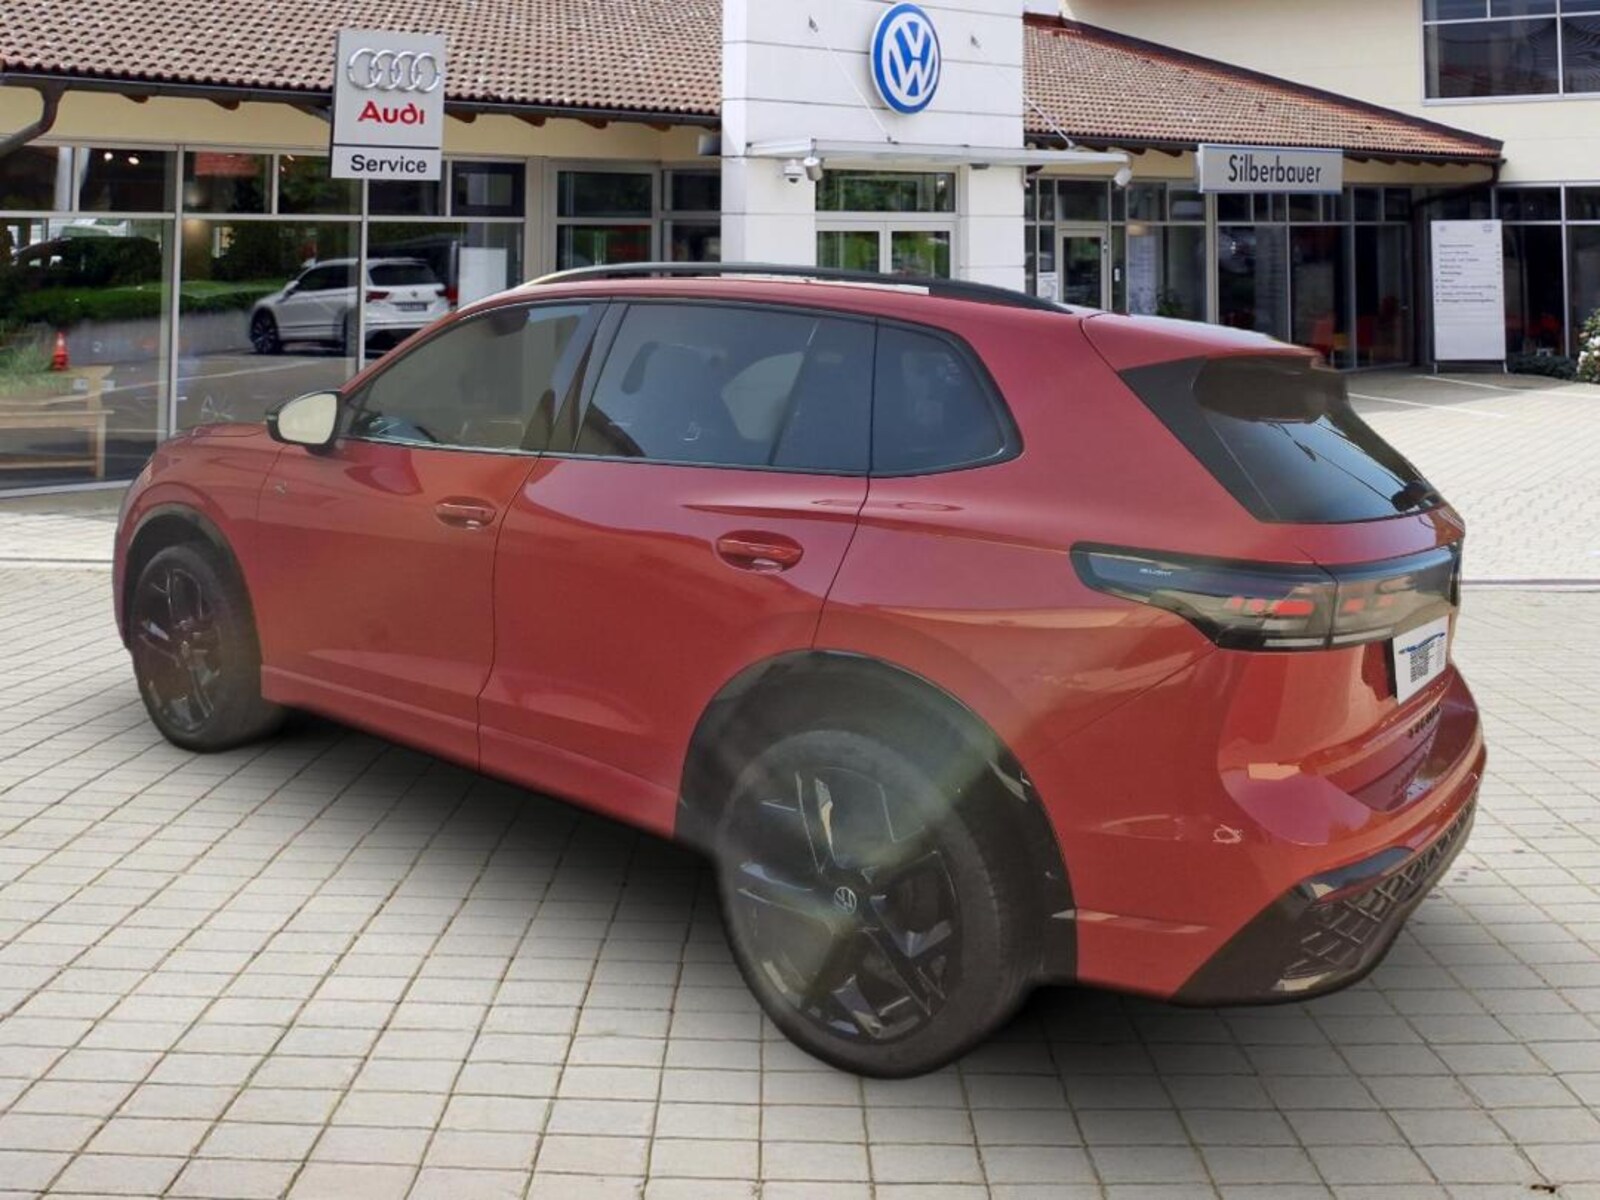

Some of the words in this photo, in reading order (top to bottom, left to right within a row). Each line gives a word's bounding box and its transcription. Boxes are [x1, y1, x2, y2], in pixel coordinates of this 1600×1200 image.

[880, 10, 937, 107] VW
[357, 100, 424, 125] Audi
[350, 153, 428, 174] Service
[1228, 153, 1322, 184] Silberbauer
